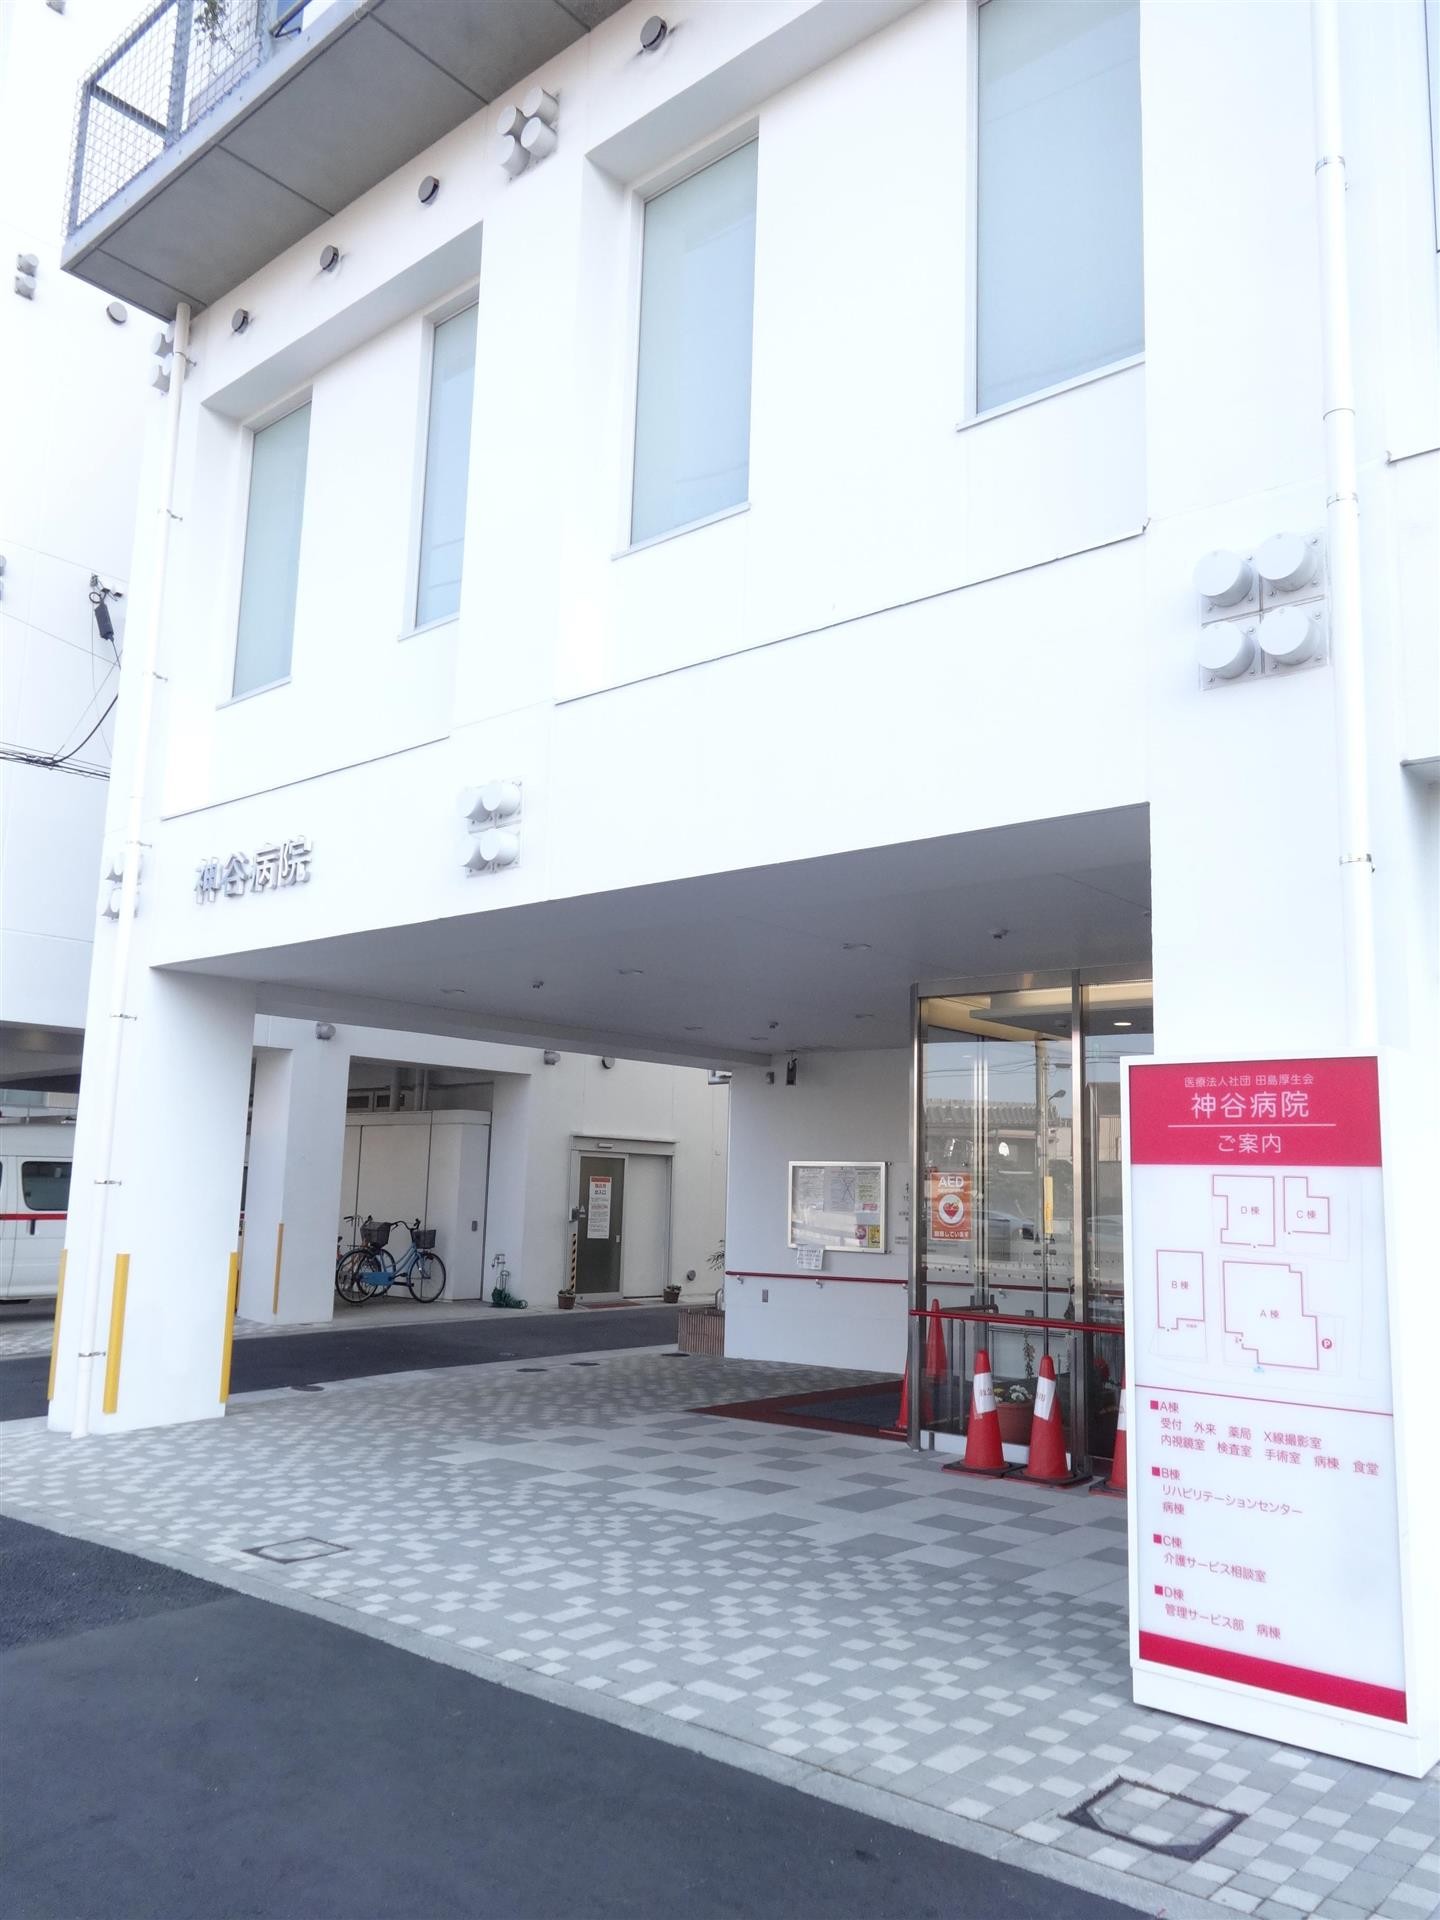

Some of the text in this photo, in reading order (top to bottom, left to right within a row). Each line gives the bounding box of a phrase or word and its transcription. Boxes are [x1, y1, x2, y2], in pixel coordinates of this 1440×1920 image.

[193, 834, 313, 905] 神谷病院
[1184, 1073, 1314, 1088] 医療法人社団 田島厚生会
[1191, 1090, 1309, 1119] 神谷病院
[1218, 1133, 1281, 1154] ご案内
[938, 1176, 964, 1188] AED
[1159, 1401, 1179, 1413] A棟
[1160, 1417, 1322, 1449] 受付 外来 薬局 X線撮影室
[1161, 1434, 1379, 1476] 内視鏡室 検査室 手術室 病棟 食堂
[1161, 1467, 1180, 1480] B棟
[1162, 1484, 1303, 1515] リハビリテーションセンター
[1162, 1501, 1184, 1515] 病棟
[1163, 1535, 1182, 1549] C棟
[1164, 1552, 1266, 1583] 介護サービス相談室
[1164, 1587, 1184, 1601] D棟
[1165, 1603, 1281, 1640] 管理サービス部 病棟
